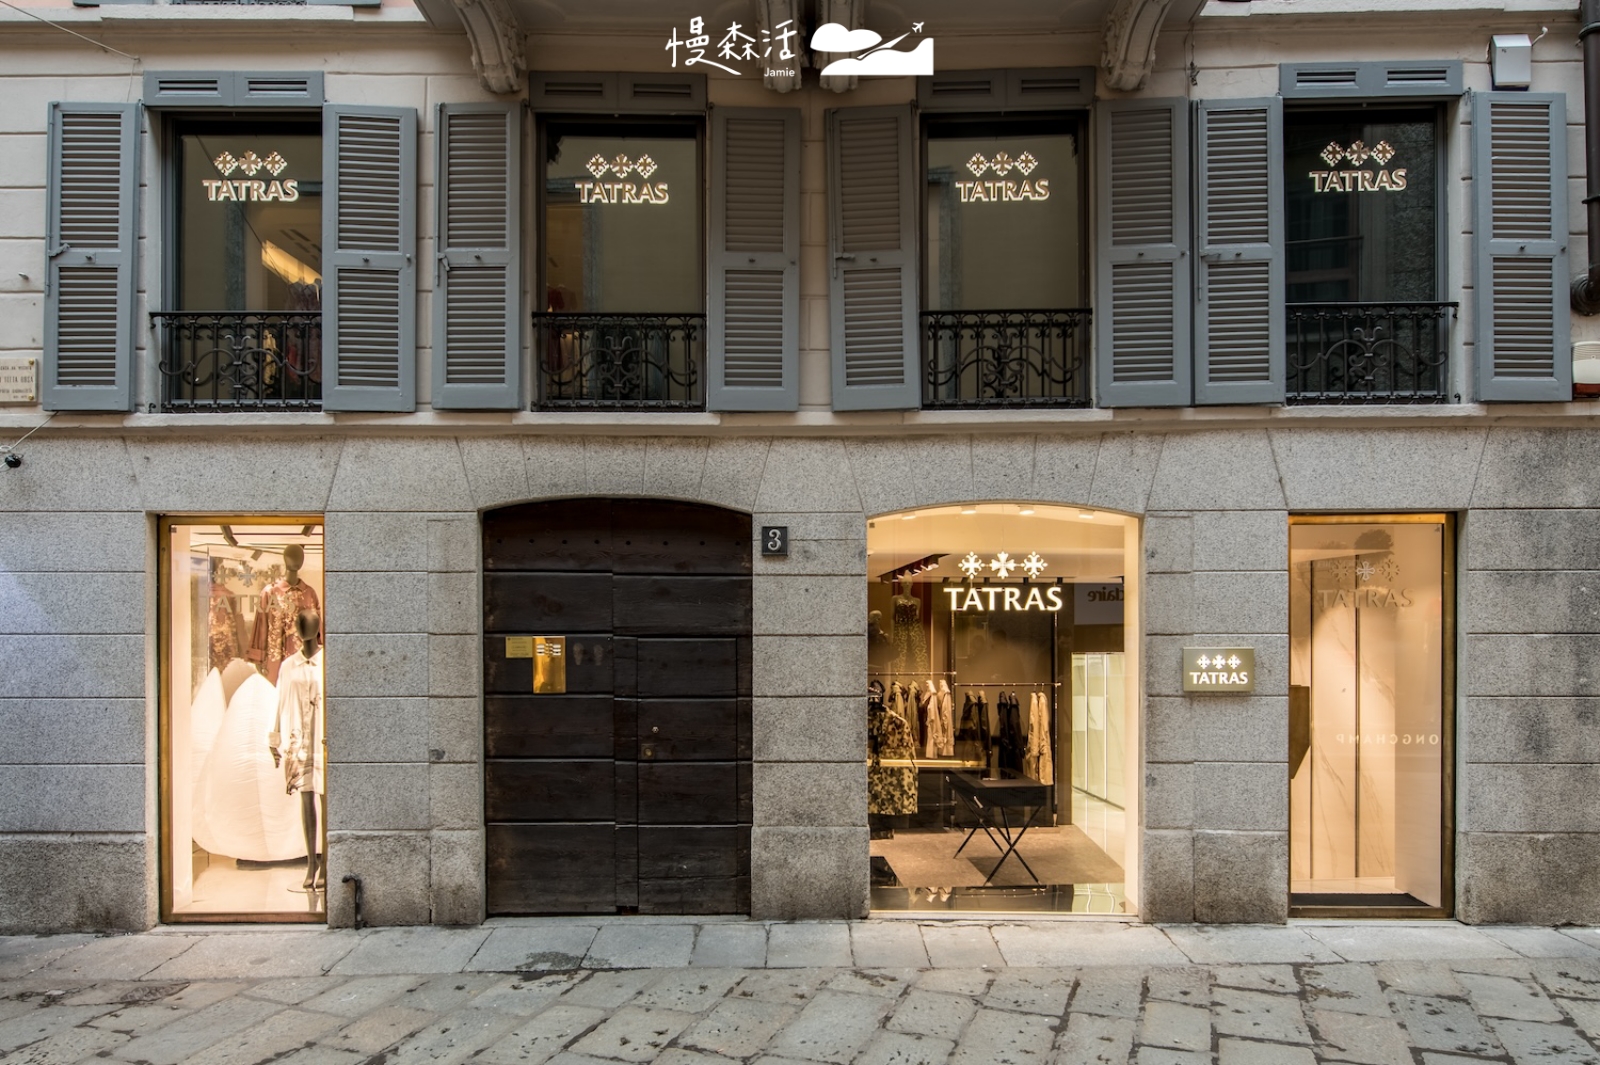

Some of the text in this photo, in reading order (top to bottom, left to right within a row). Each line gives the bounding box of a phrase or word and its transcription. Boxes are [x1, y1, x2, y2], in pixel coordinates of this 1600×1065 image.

[202, 179, 299, 202] TATRAS
[955, 178, 1050, 202] TATRAS
[1309, 168, 1407, 192] TATRAS
[574, 181, 669, 204] TATRAS
[767, 529, 781, 551] 3
[943, 587, 1063, 611] TATRAS
[1317, 588, 1414, 608] TATRAS
[1189, 671, 1248, 685] TATRAS
